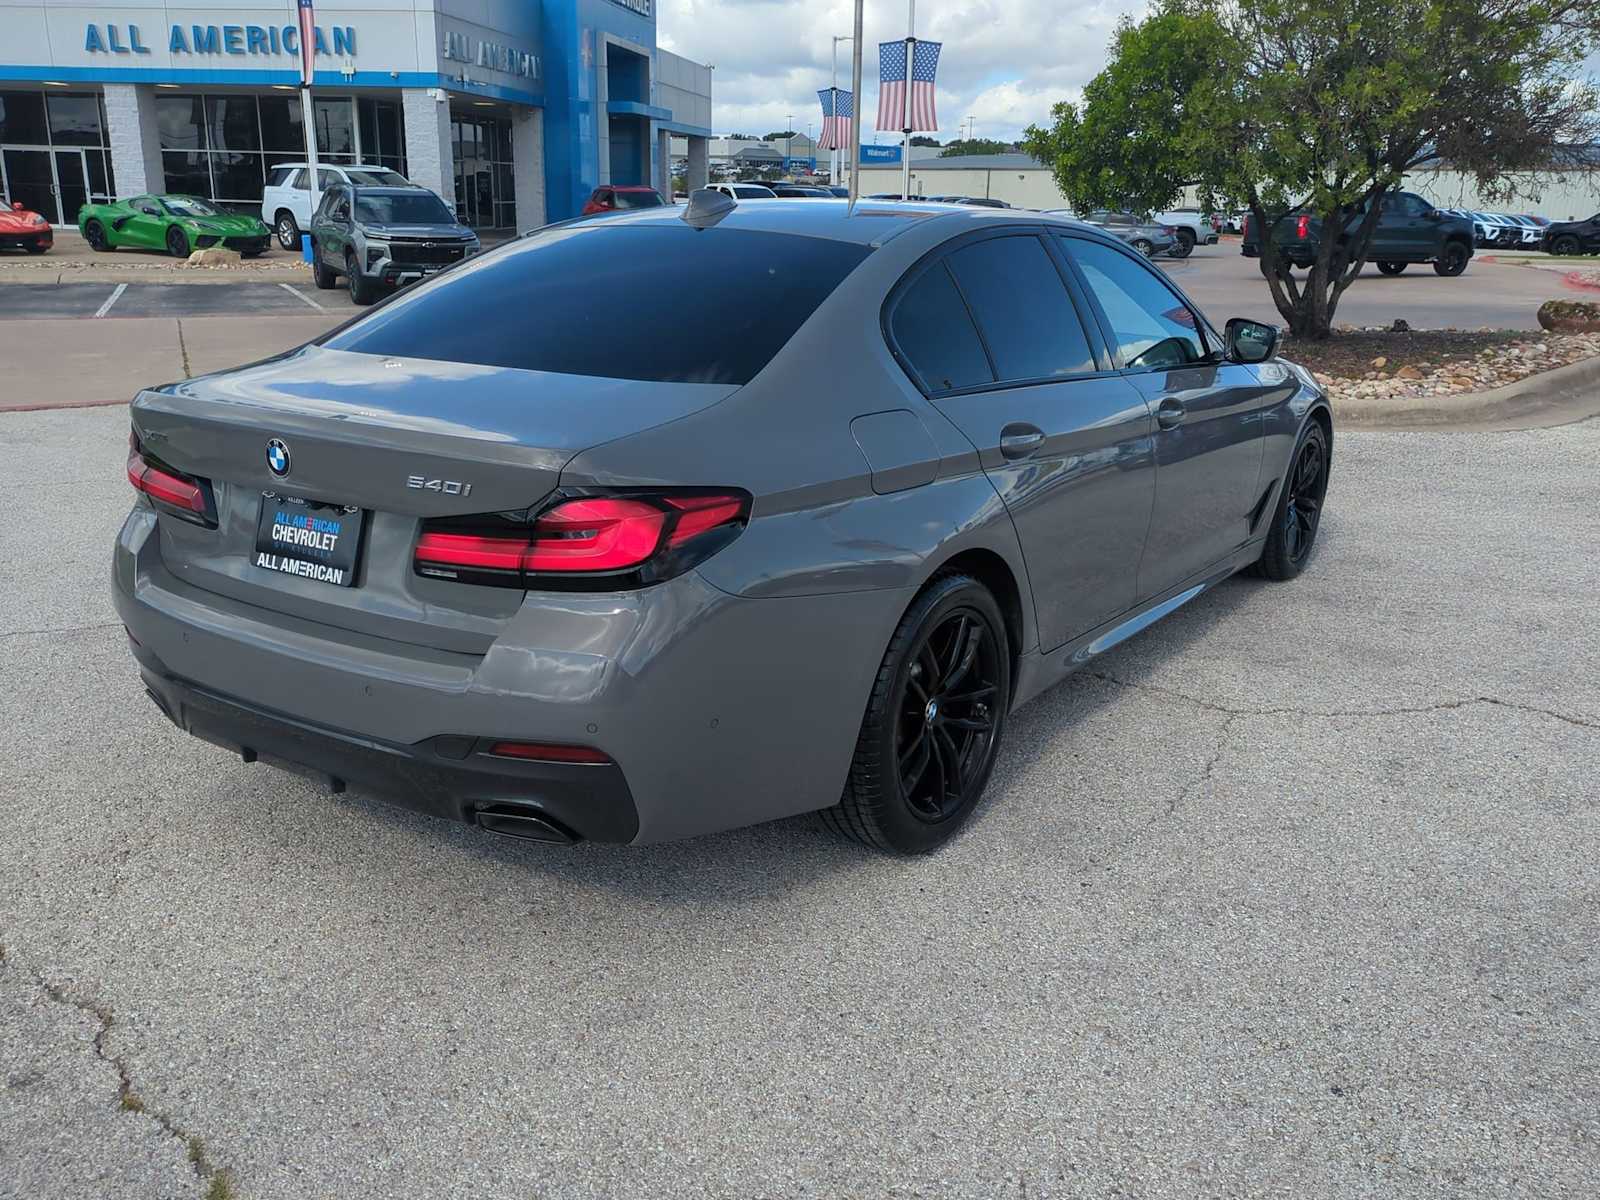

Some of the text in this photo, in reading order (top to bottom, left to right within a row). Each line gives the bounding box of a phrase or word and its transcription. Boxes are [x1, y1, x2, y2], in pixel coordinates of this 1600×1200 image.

[85, 24, 357, 56] ALL AMERICAN
[406, 475, 472, 497] 540i
[275, 512, 340, 533] ALL AMERICAN
[272, 524, 338, 551] CHEVROLET
[257, 552, 343, 584] ALL AMERICAN
